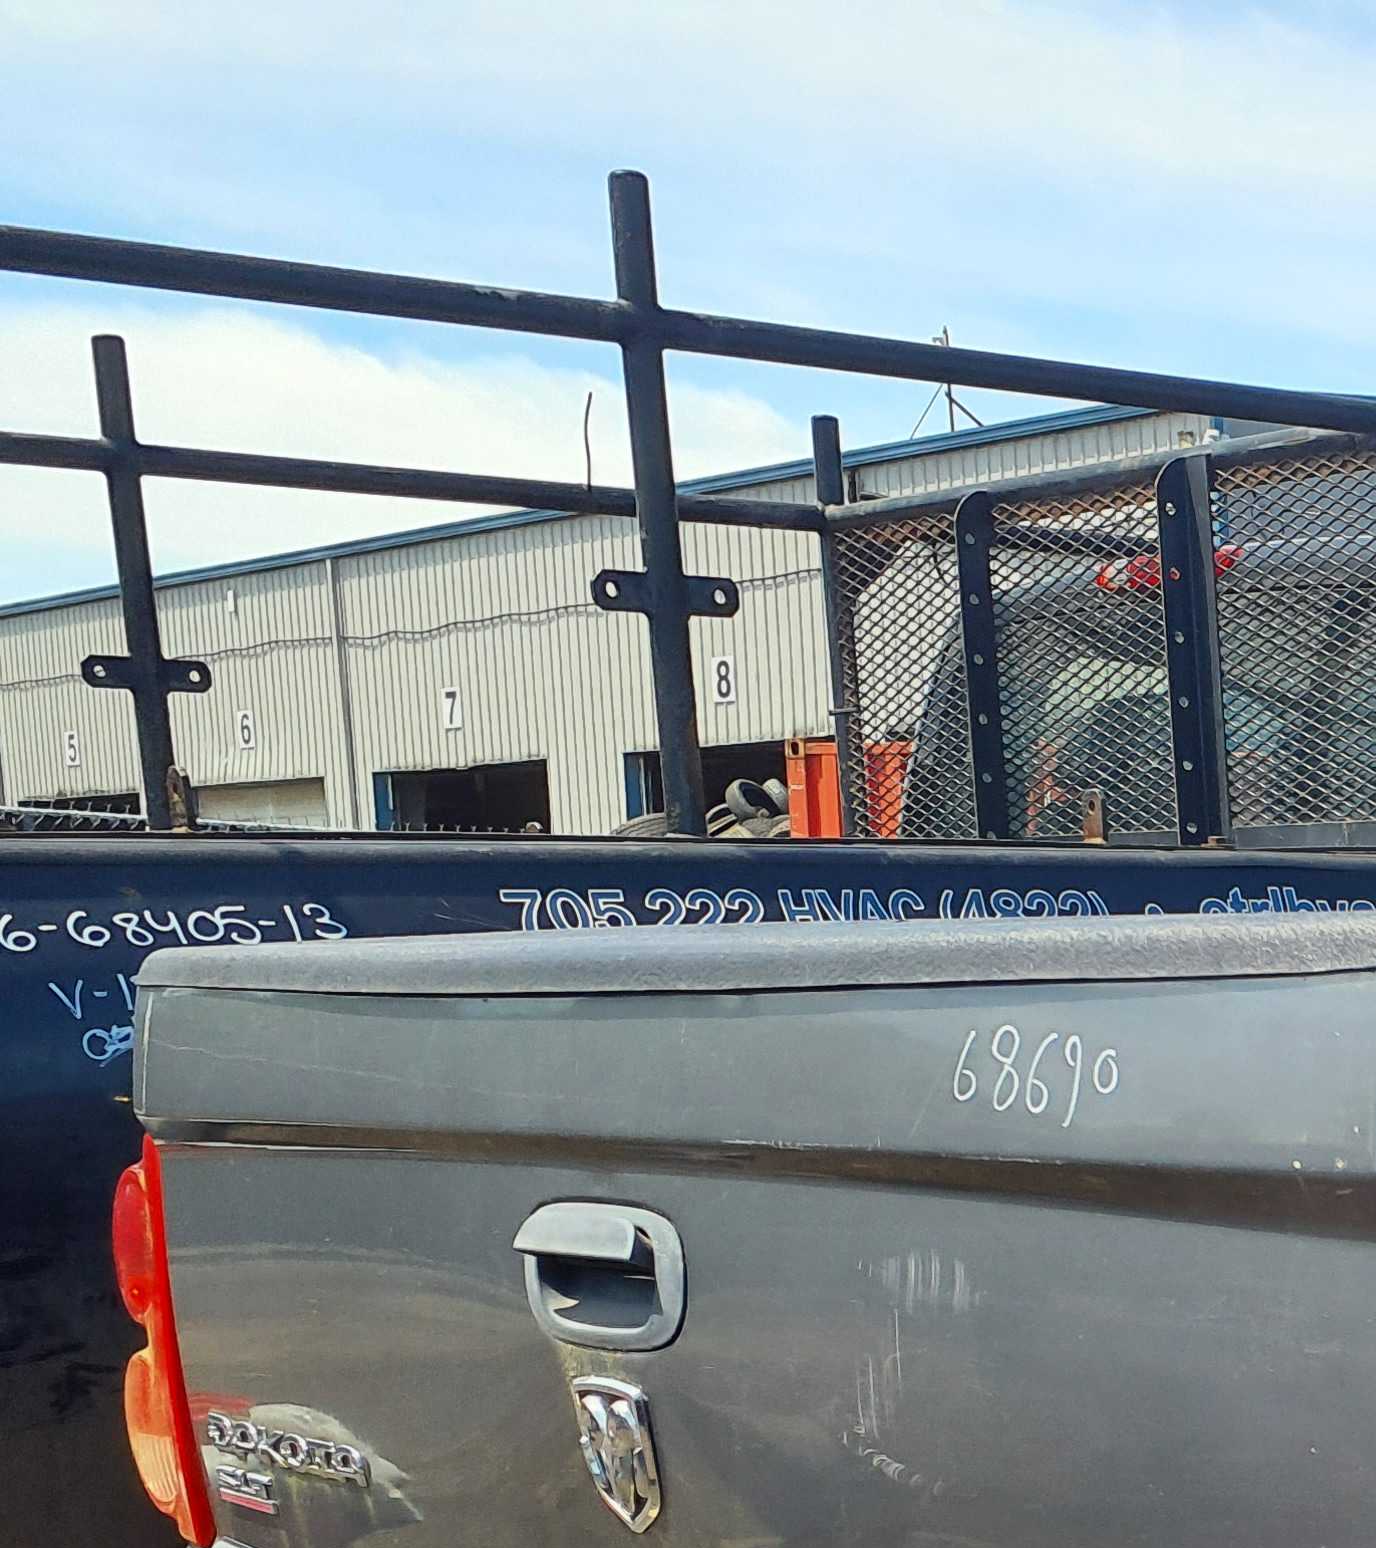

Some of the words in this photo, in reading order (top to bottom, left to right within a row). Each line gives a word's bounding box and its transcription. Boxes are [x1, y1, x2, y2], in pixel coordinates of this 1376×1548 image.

[716, 659, 731, 699] 8
[444, 690, 458, 725] 7
[67, 733, 78, 763] 5
[240, 713, 252, 745] 6
[499, 888, 637, 932] 705
[645, 888, 764, 926] 222
[776, 888, 925, 922] HVAC
[953, 1024, 1119, 1128] 68690
[207, 1410, 371, 1489] DAKOTA
